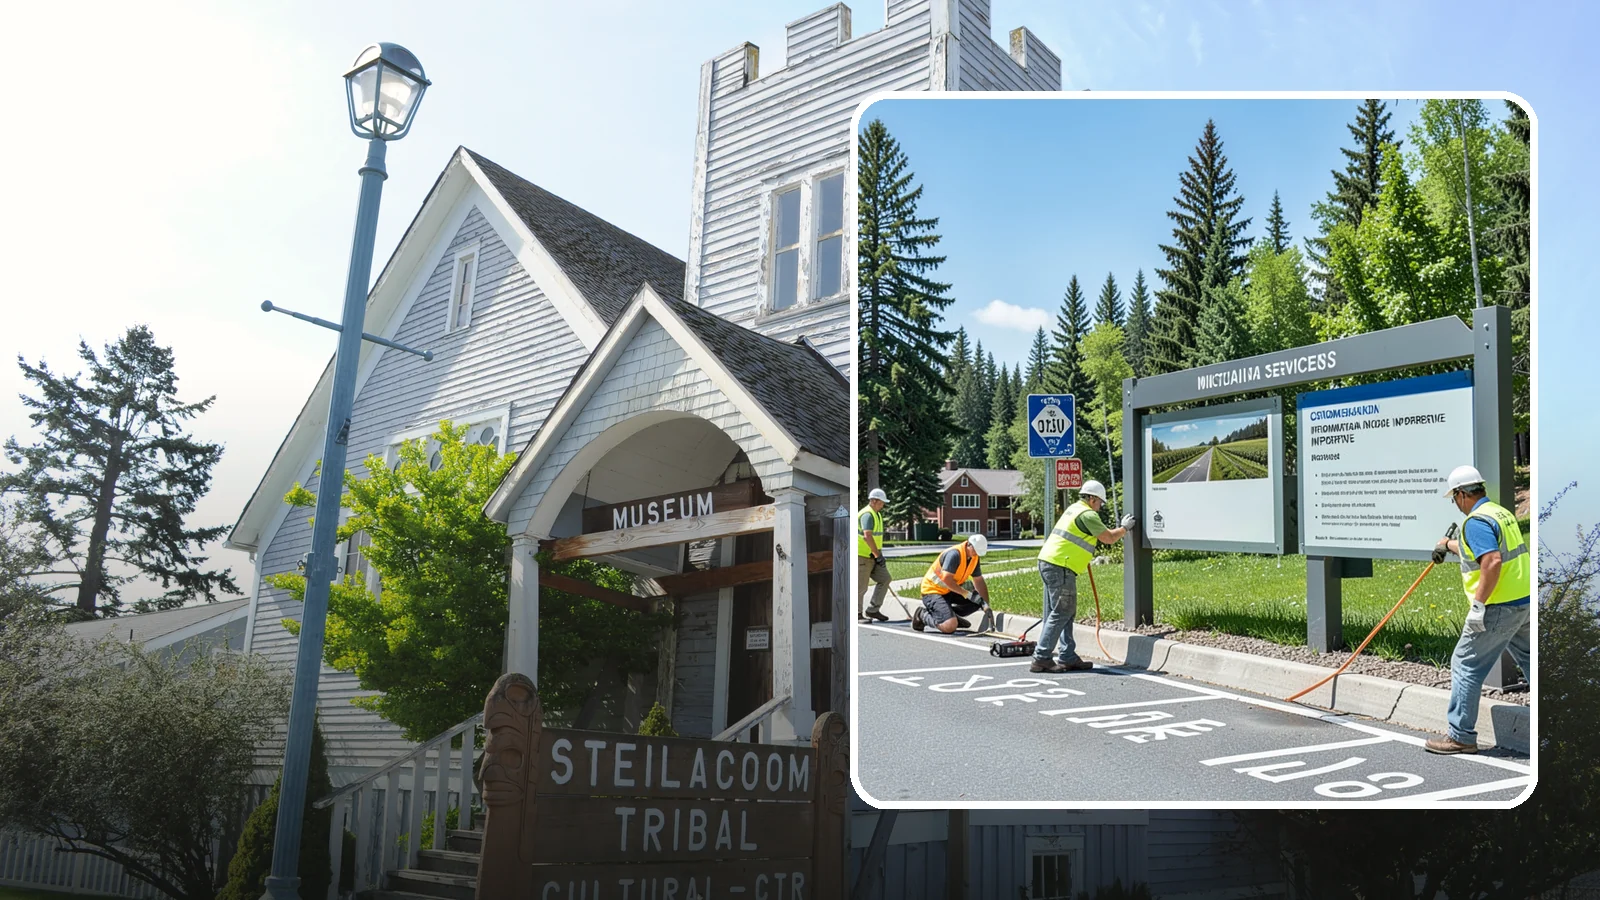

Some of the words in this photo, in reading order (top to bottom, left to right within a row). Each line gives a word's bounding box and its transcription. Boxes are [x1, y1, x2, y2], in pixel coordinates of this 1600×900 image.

[612, 491, 714, 530] MUSEUM
[550, 737, 810, 792] STEILACOOM
[615, 806, 758, 852] TRIBAL
